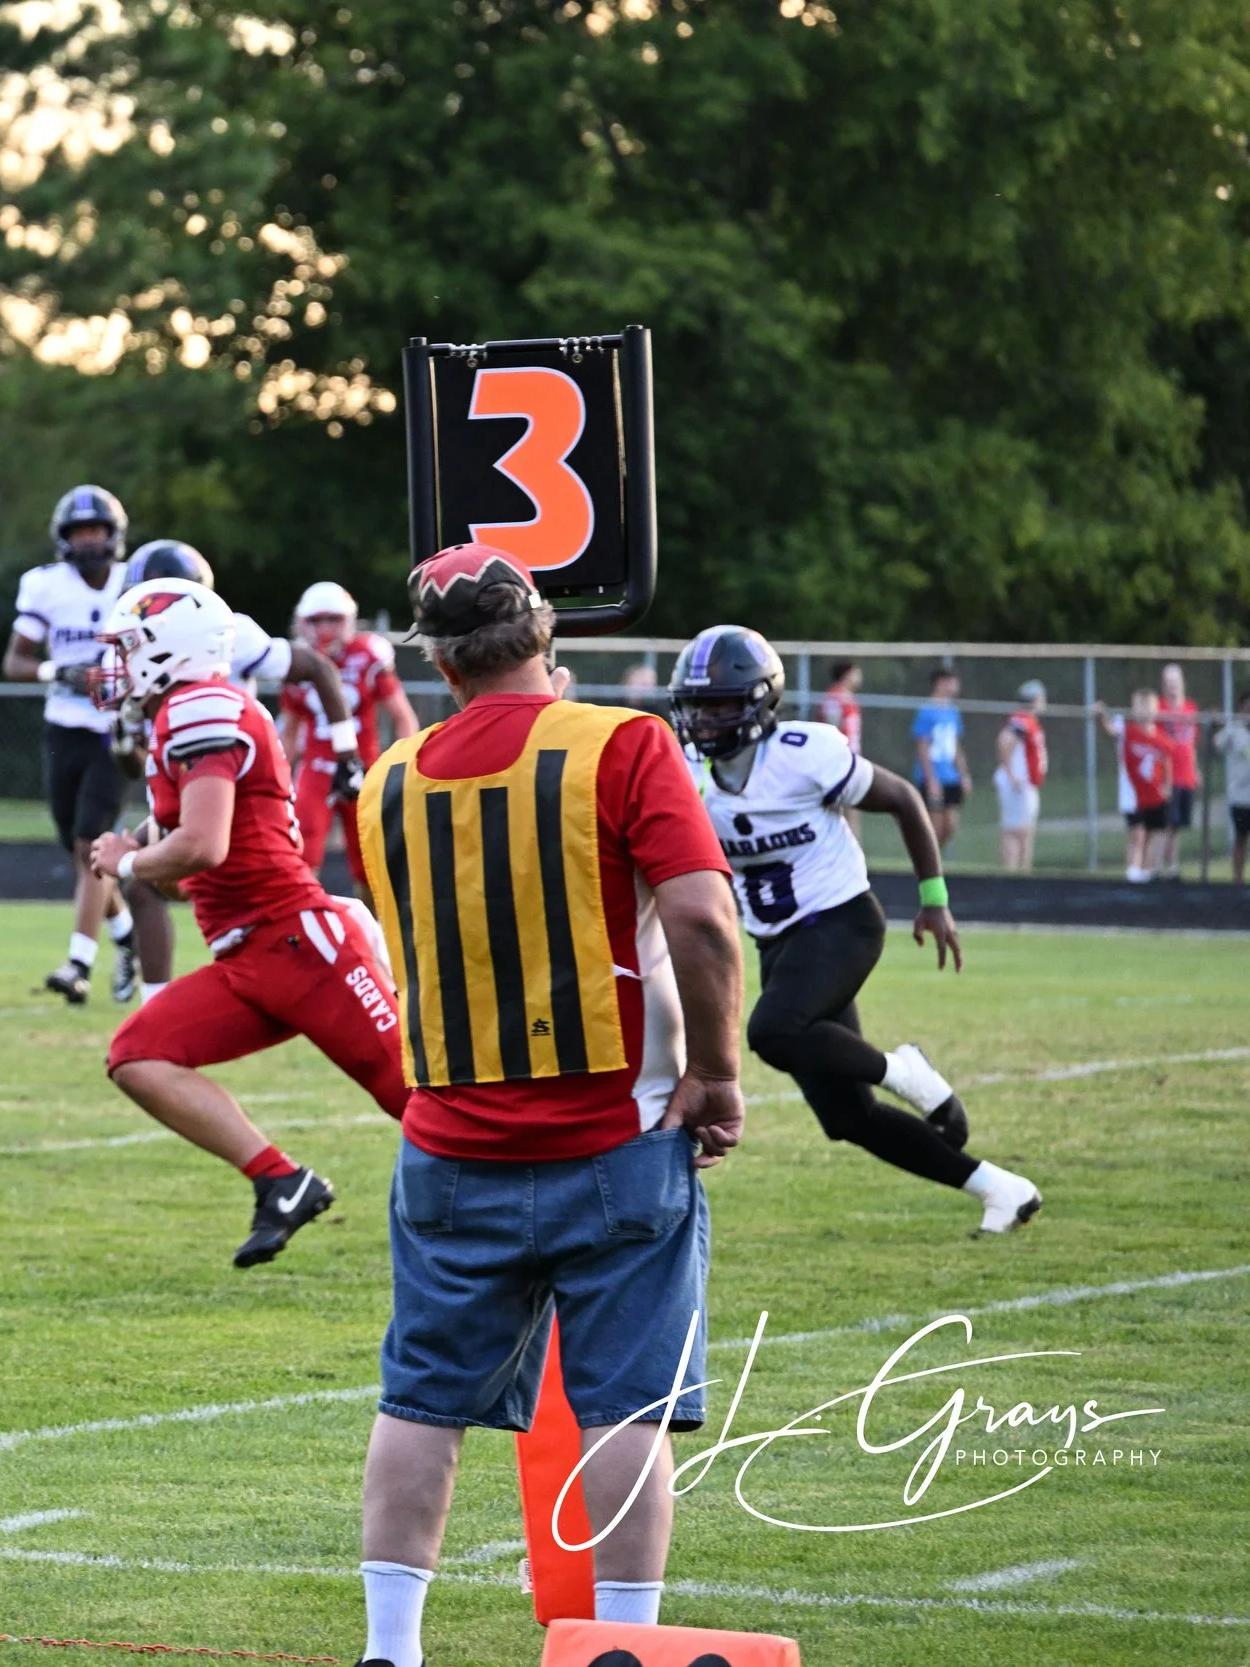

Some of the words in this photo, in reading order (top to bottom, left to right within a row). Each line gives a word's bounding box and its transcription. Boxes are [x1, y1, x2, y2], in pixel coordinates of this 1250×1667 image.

[467, 366, 595, 571] 3
[780, 731, 809, 748] 0
[719, 822, 817, 857] ARAOHS
[743, 860, 800, 924] 0
[345, 965, 398, 1033] CARDS
